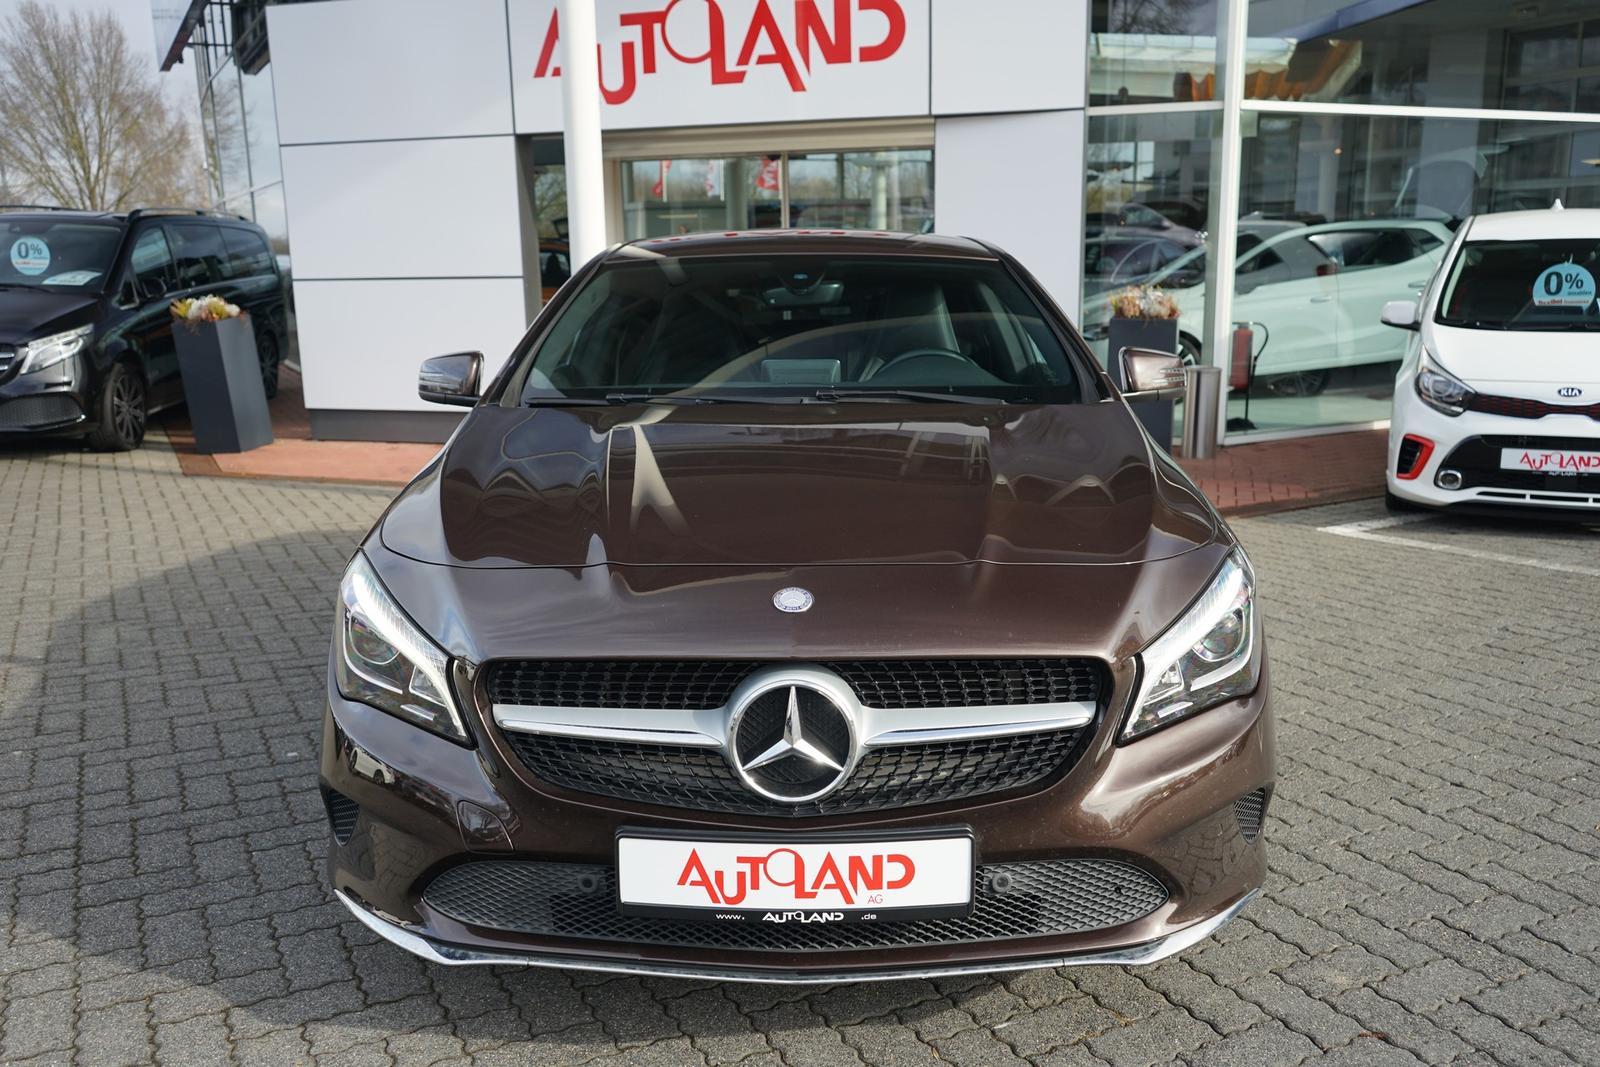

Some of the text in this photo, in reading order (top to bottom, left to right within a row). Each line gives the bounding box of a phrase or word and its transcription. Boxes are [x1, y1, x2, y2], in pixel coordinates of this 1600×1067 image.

[17, 242, 42, 259] 0%
[1543, 271, 1584, 296] 0%
[1560, 388, 1580, 396] KIA
[1520, 451, 1600, 471] AUTOLAND
[677, 848, 915, 905] AUTOLAND
[867, 894, 884, 905] AG
[762, 910, 844, 923] AUTOLAND
